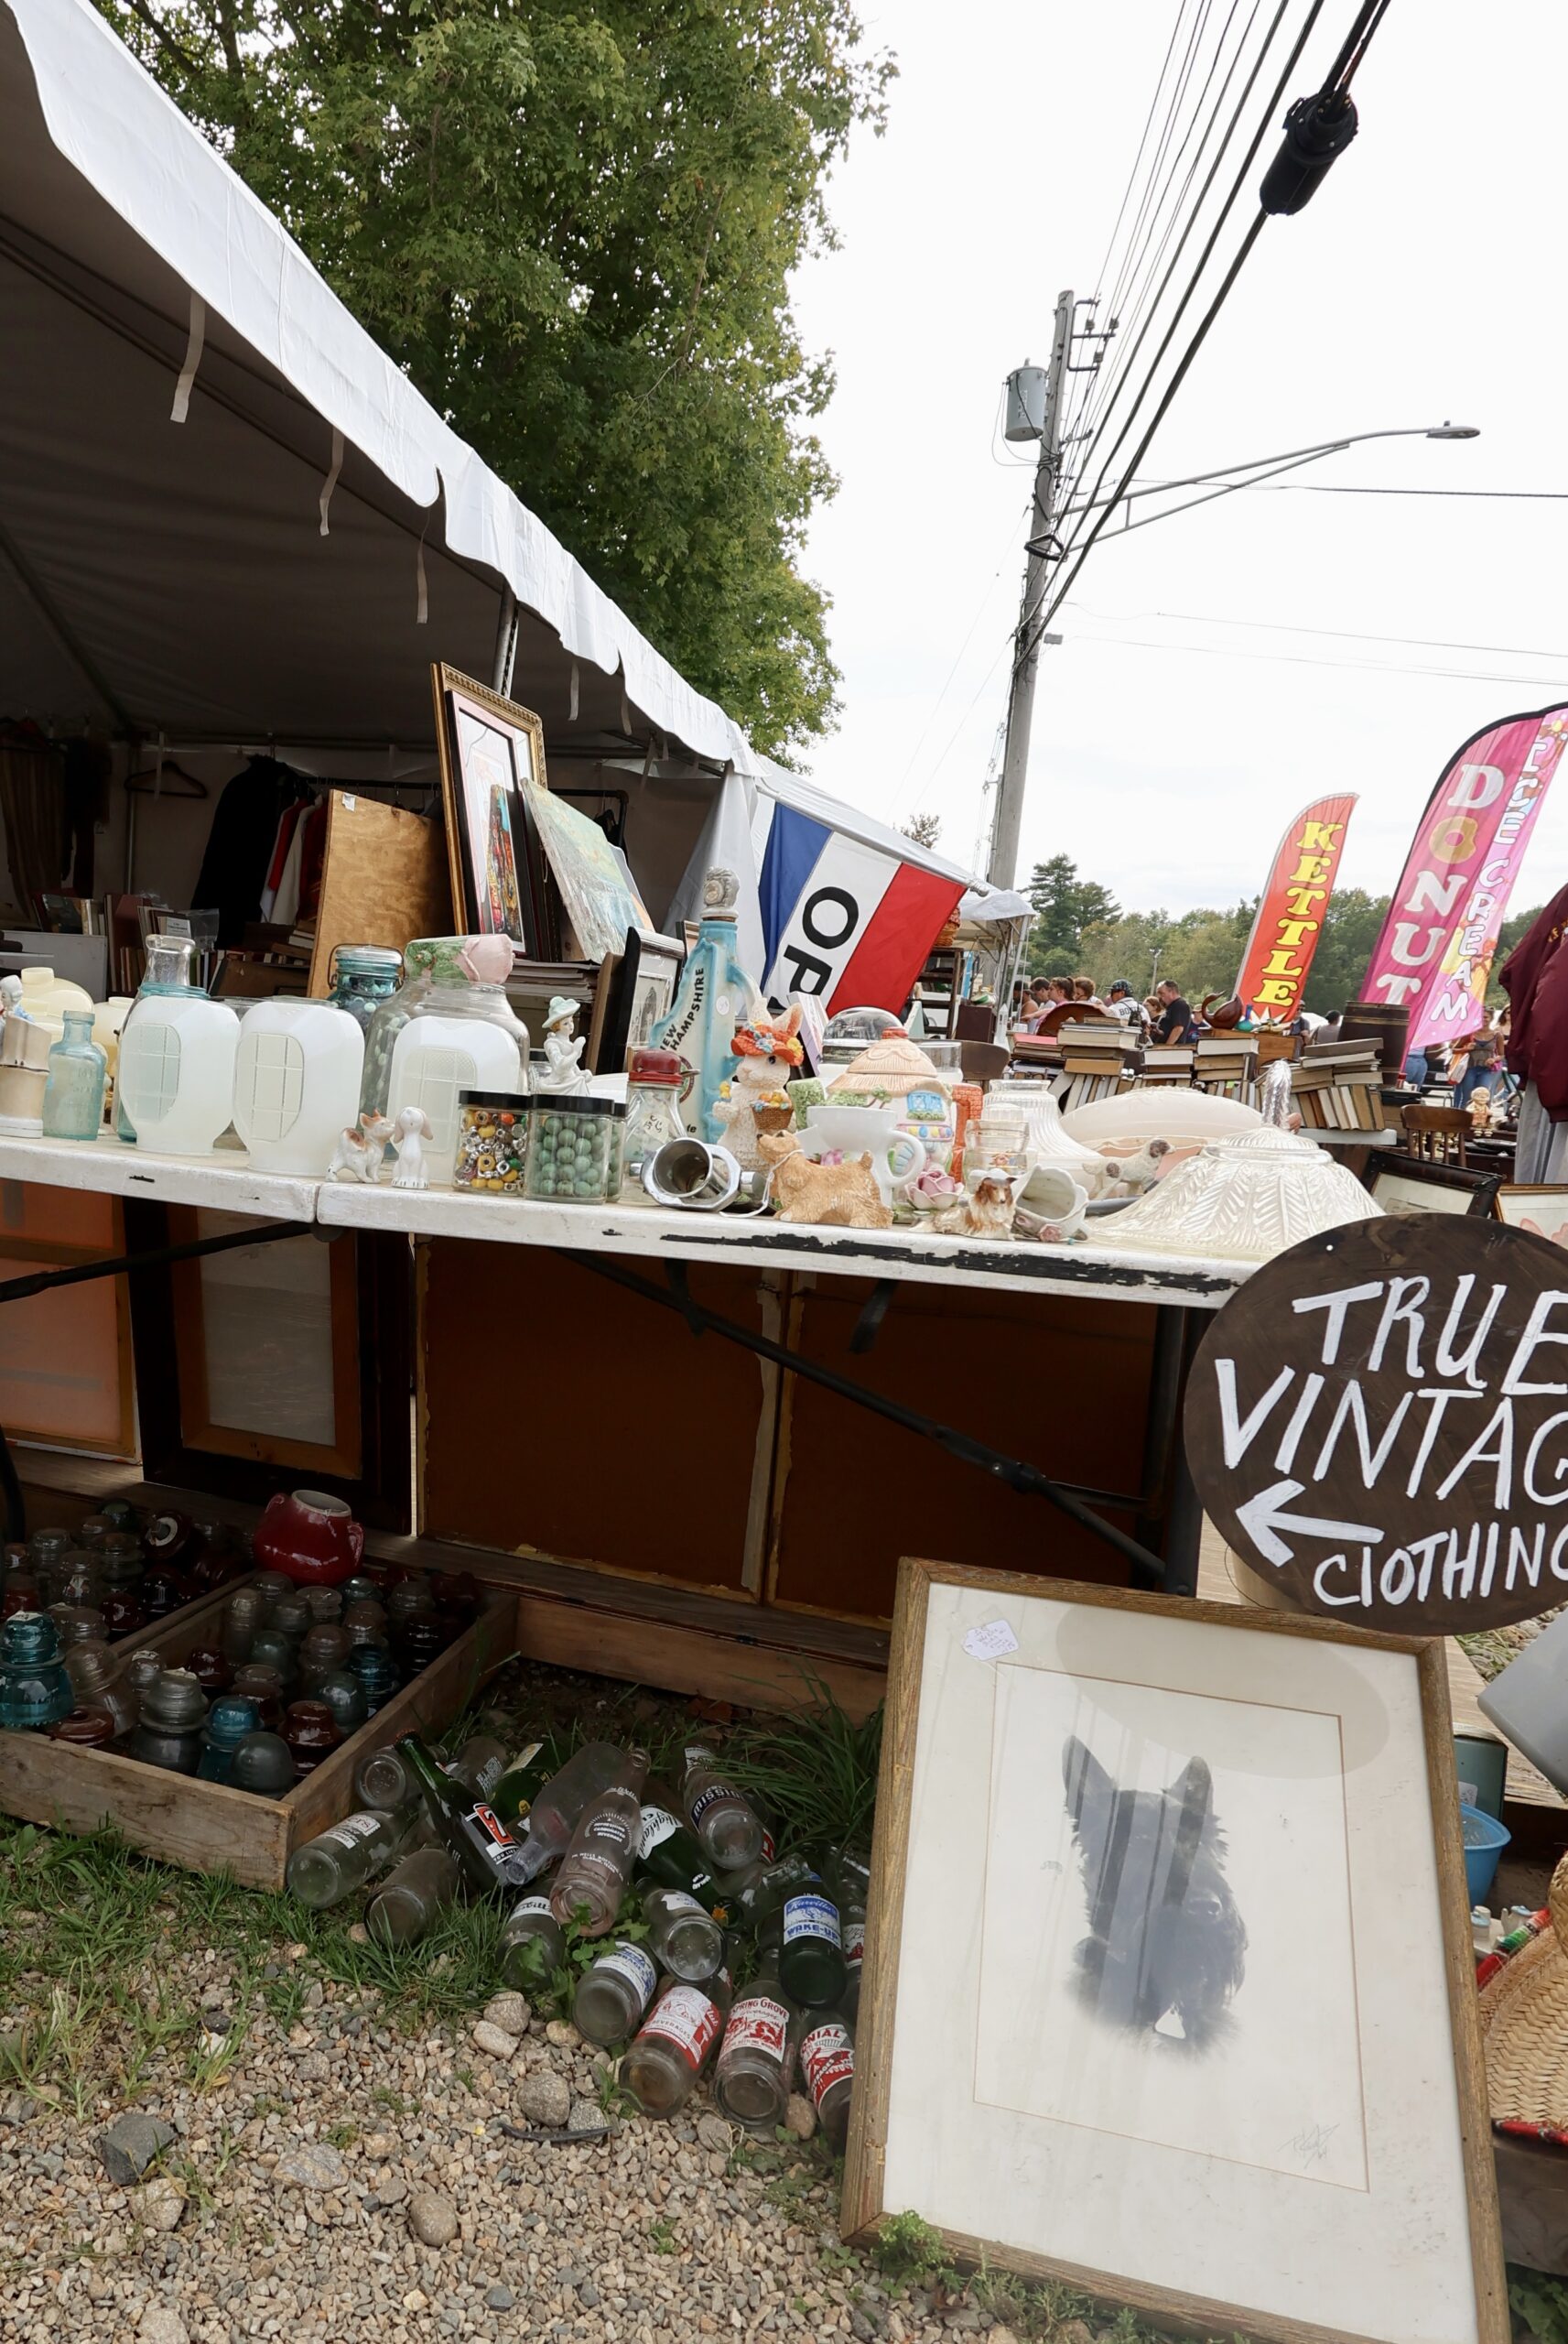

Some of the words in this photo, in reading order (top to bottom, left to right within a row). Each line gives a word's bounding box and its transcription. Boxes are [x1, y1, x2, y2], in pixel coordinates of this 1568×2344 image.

[784, 886, 859, 995] OP
[1252, 820, 1344, 1006] KETTLE
[1376, 764, 1505, 1004] DONUT
[1430, 859, 1509, 1021] CREAM
[670, 968, 704, 1051] HAMPSHIRE
[1292, 1274, 1568, 1396] TRUE
[1215, 1358, 1568, 1510] VINTAG
[761, 1998, 787, 2020] GROVE
